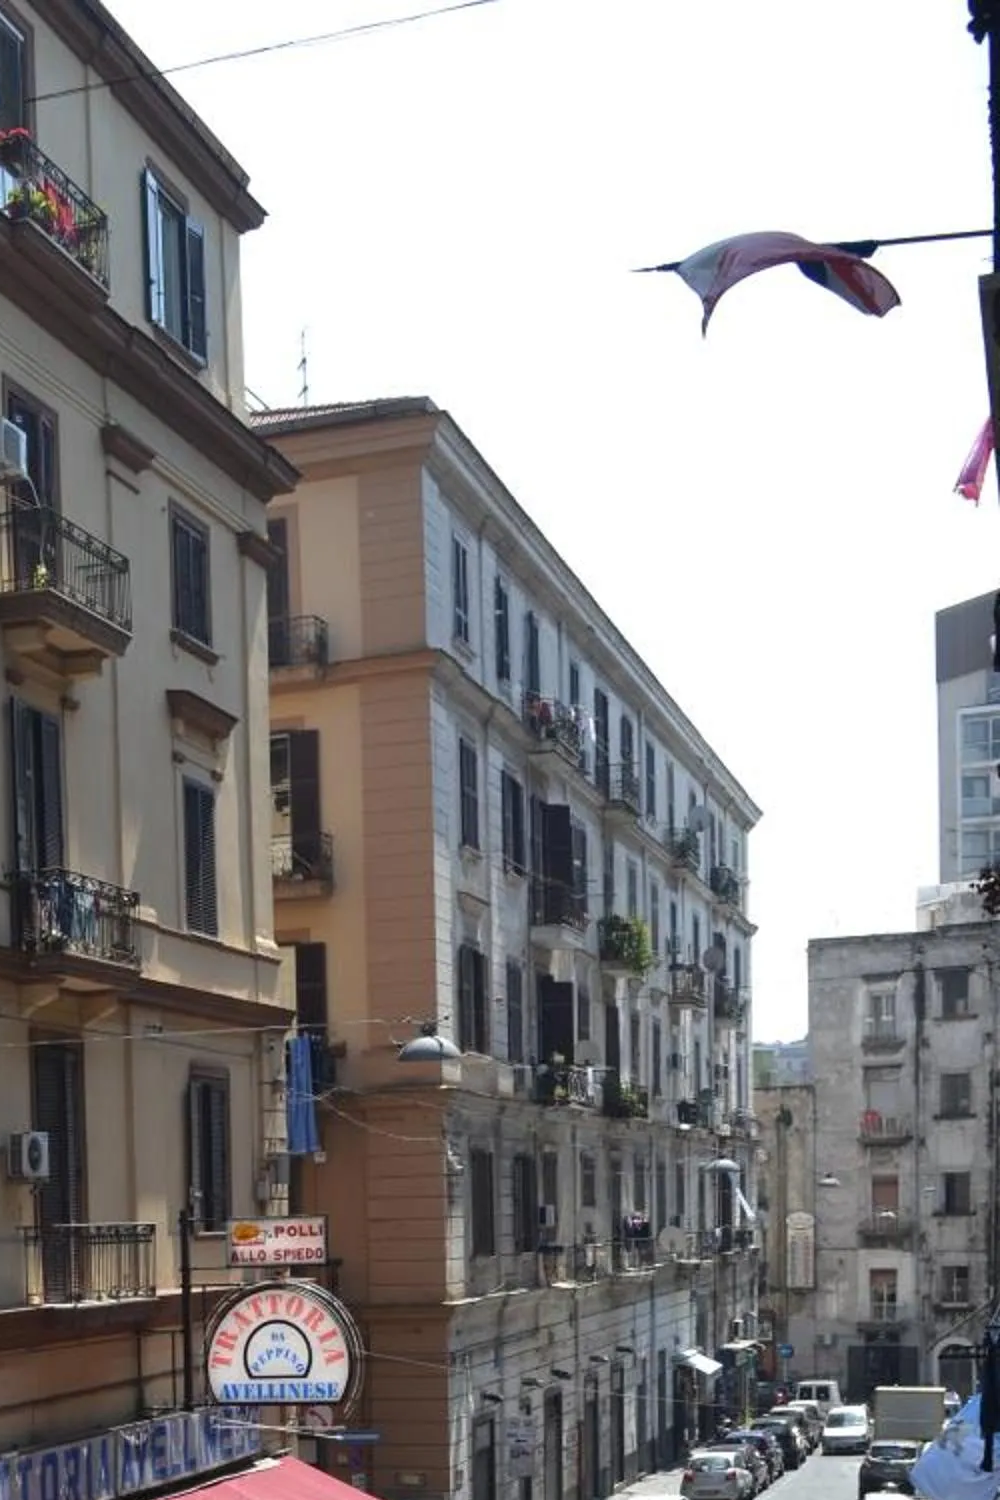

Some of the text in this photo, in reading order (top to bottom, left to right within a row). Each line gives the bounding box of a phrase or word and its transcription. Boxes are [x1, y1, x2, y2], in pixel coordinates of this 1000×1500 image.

[274, 1224, 323, 1239] POLLI
[231, 1247, 324, 1263] ALLO SPIEDO
[212, 1295, 345, 1368] TRATTORIA
[252, 1346, 304, 1373] PEPPINO
[221, 1383, 339, 1400] AVELLINESE
